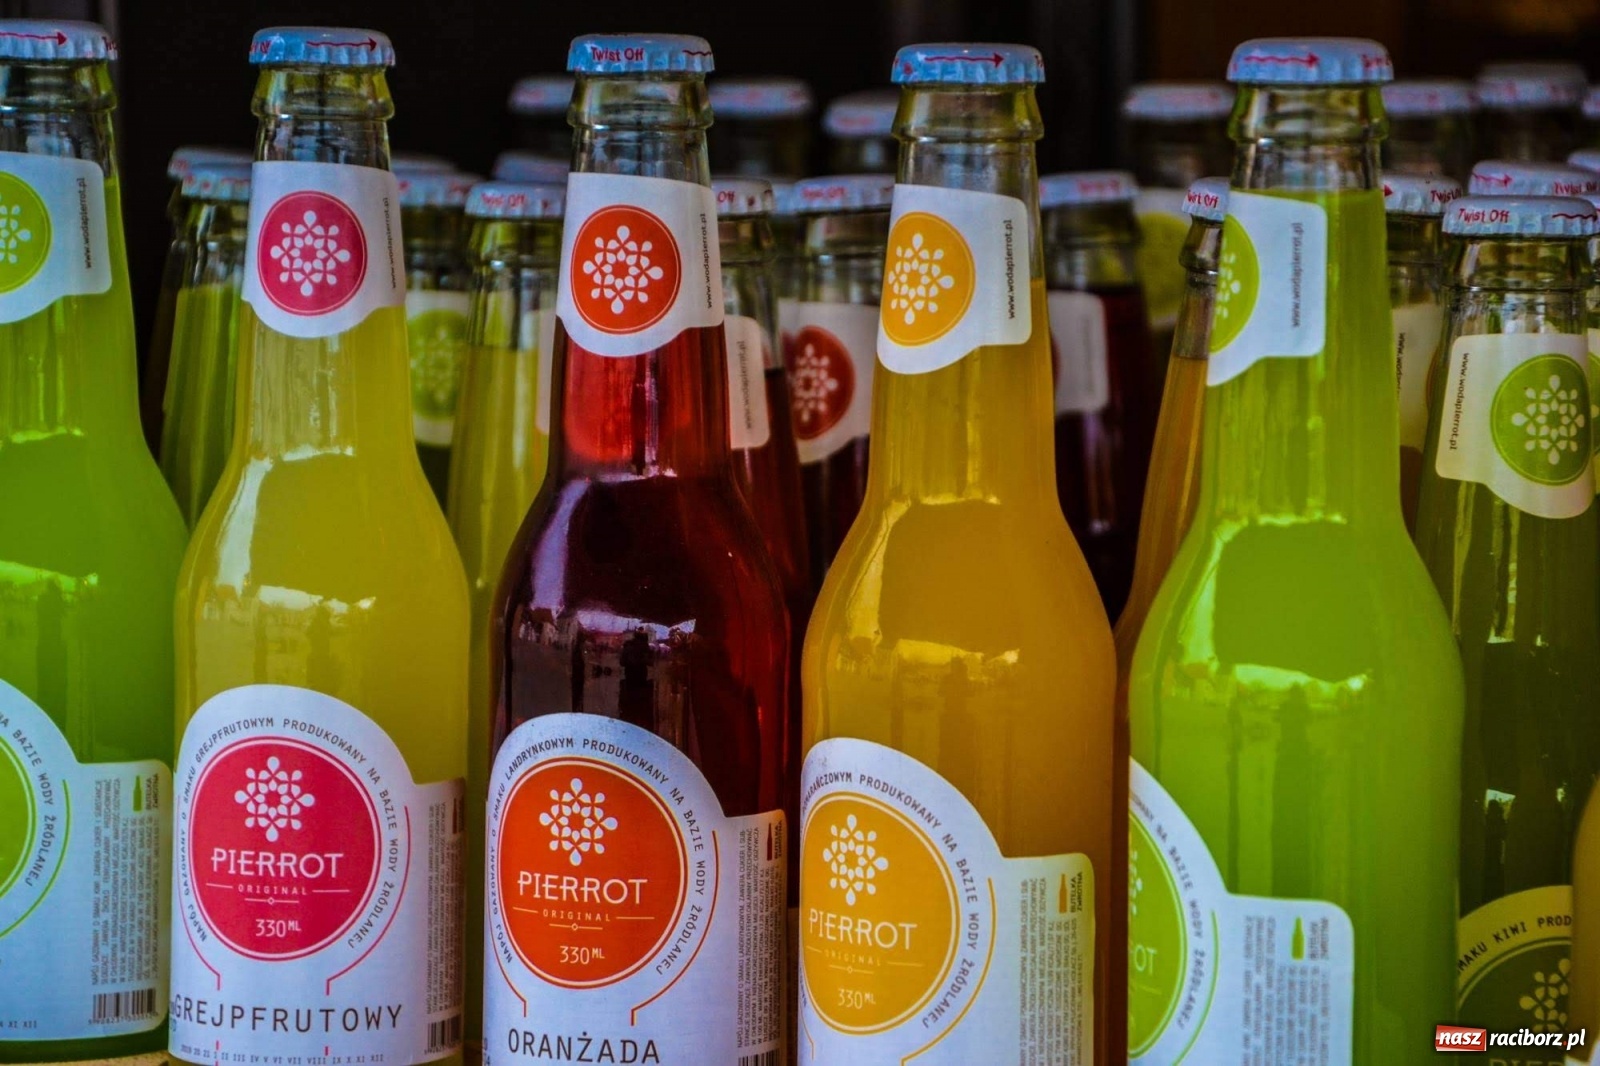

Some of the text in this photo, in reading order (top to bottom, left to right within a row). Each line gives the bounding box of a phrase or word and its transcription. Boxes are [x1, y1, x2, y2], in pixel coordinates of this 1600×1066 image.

[591, 47, 644, 62] Twist Off
[717, 190, 735, 203] Off
[1554, 181, 1583, 195] Twist
[77, 177, 91, 269] www.wodapierrot.pl
[1459, 208, 1510, 223] Twist Off
[699, 213, 714, 309] www.wodapierrot.pl
[1003, 219, 1016, 320] www.wodapierrot.pl
[1449, 352, 1470, 450] www.wodapierrot.pl
[195, 717, 275, 763] GREJPFRUTOWYM
[283, 718, 367, 764] PRODUKOWANY
[504, 737, 574, 781] LANDRYNKOWYM
[12, 729, 42, 767] BAZIE
[38, 772, 55, 806] WODY
[367, 767, 381, 785] NA
[582, 738, 670, 785] PRODUKOWANY
[183, 766, 196, 804] SMAKU
[493, 782, 505, 821] SMAKU
[669, 787, 685, 805] NA
[379, 789, 397, 831] BAZIE
[491, 829, 496, 837] O
[683, 810, 704, 852] BAZIE
[180, 828, 191, 896] GAZOWANY
[211, 847, 344, 879] PIERROT
[388, 838, 399, 872] WODY
[860, 774, 941, 829] PRODUKOWANY
[941, 834, 958, 852] NA
[956, 858, 978, 903] BAZIE
[967, 912, 980, 950] WODY
[238, 884, 308, 896] ORIGINAL
[489, 845, 499, 916] GAZOWANY
[517, 870, 648, 904] PIERROT
[695, 860, 706, 895] WODY
[187, 904, 208, 943] NAPÓJ
[543, 908, 611, 922] ORIGINAL
[809, 908, 917, 950] PIERROT
[495, 924, 513, 963] NAPÓJ
[1456, 942, 1488, 974] MAKU
[1493, 921, 1528, 943] KIWI
[174, 993, 403, 1033] GREJPFRUTOWY
[250, 1054, 259, 1063] IV
[263, 1055, 269, 1063] V
[273, 1056, 283, 1065] VI
[287, 1056, 301, 1065] VII
[306, 1056, 327, 1065] VIII
[332, 1056, 342, 1065] IX
[356, 1055, 365, 1064] XI
[370, 1053, 384, 1063] XII
[508, 1028, 661, 1064] ORANŻADA
